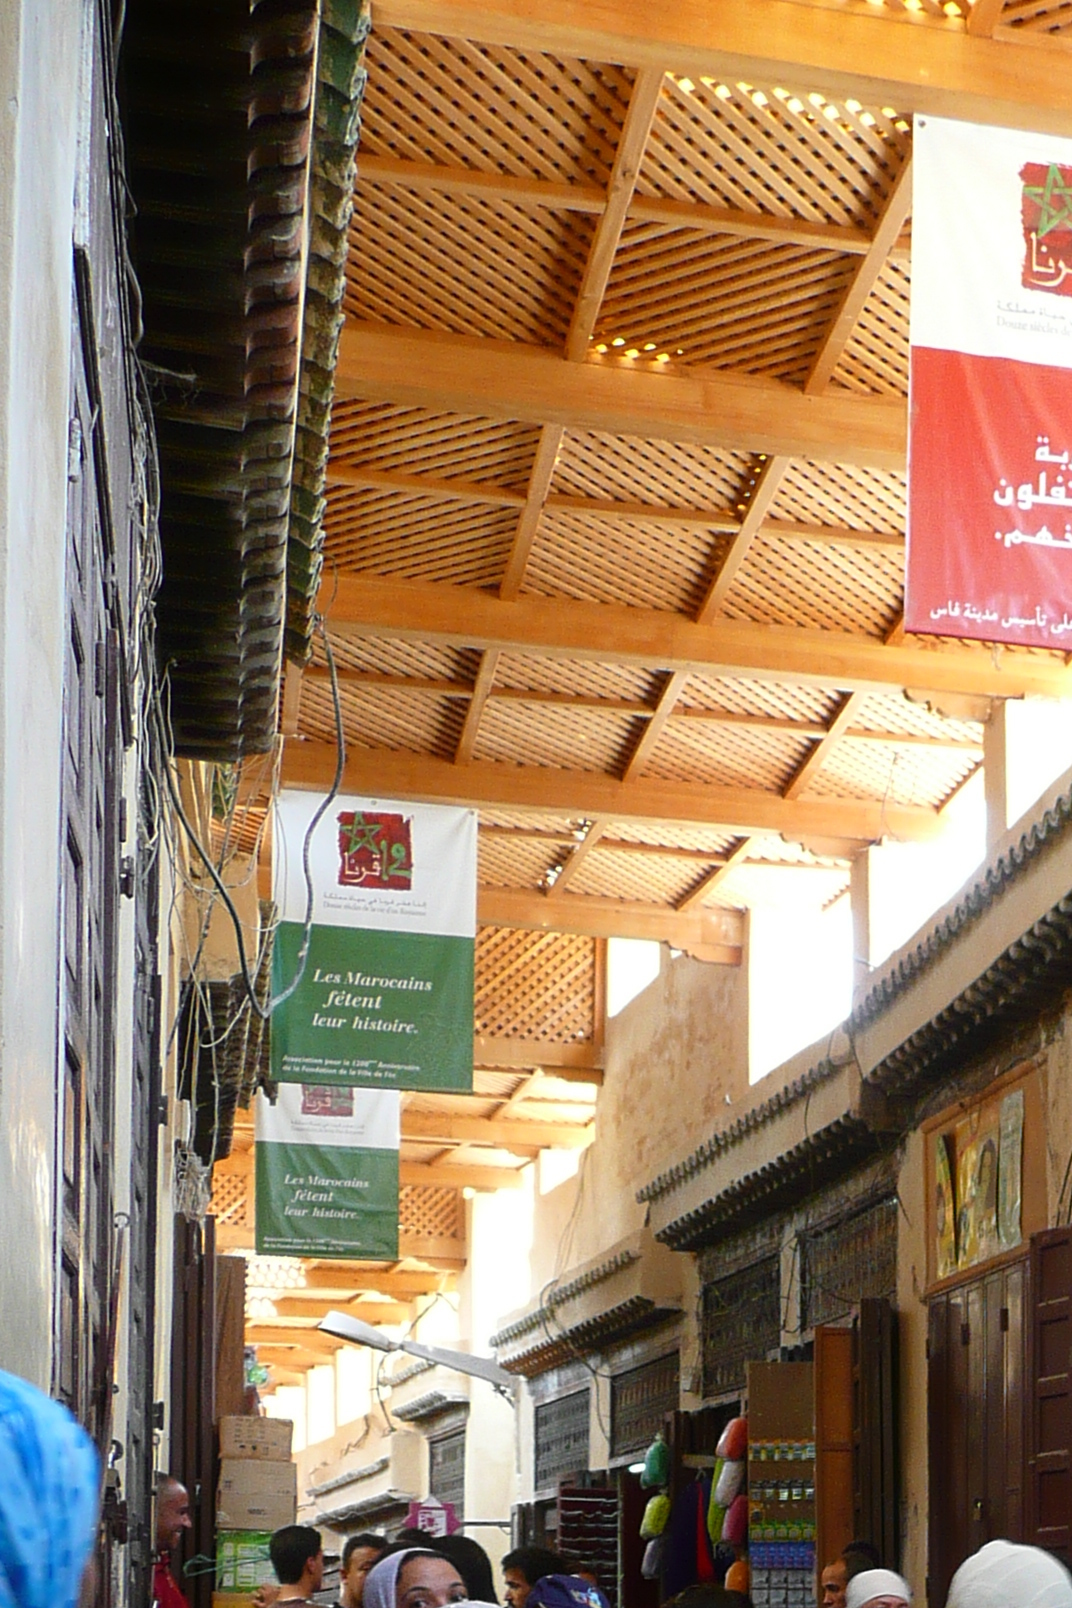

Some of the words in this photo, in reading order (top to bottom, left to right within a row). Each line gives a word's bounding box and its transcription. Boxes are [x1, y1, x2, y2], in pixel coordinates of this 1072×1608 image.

[930, 599, 961, 621] فاس
[962, 604, 999, 624] مدينة
[1001, 606, 1048, 628] تأسيس
[342, 852, 381, 883] قرنا
[313, 968, 342, 983] Les
[344, 970, 433, 991] Marocains
[312, 1012, 348, 1027] leur
[353, 1015, 419, 1034] histoire.
[284, 1173, 305, 1186] Les
[308, 1175, 369, 1189] Marocains
[284, 1206, 309, 1216] leur
